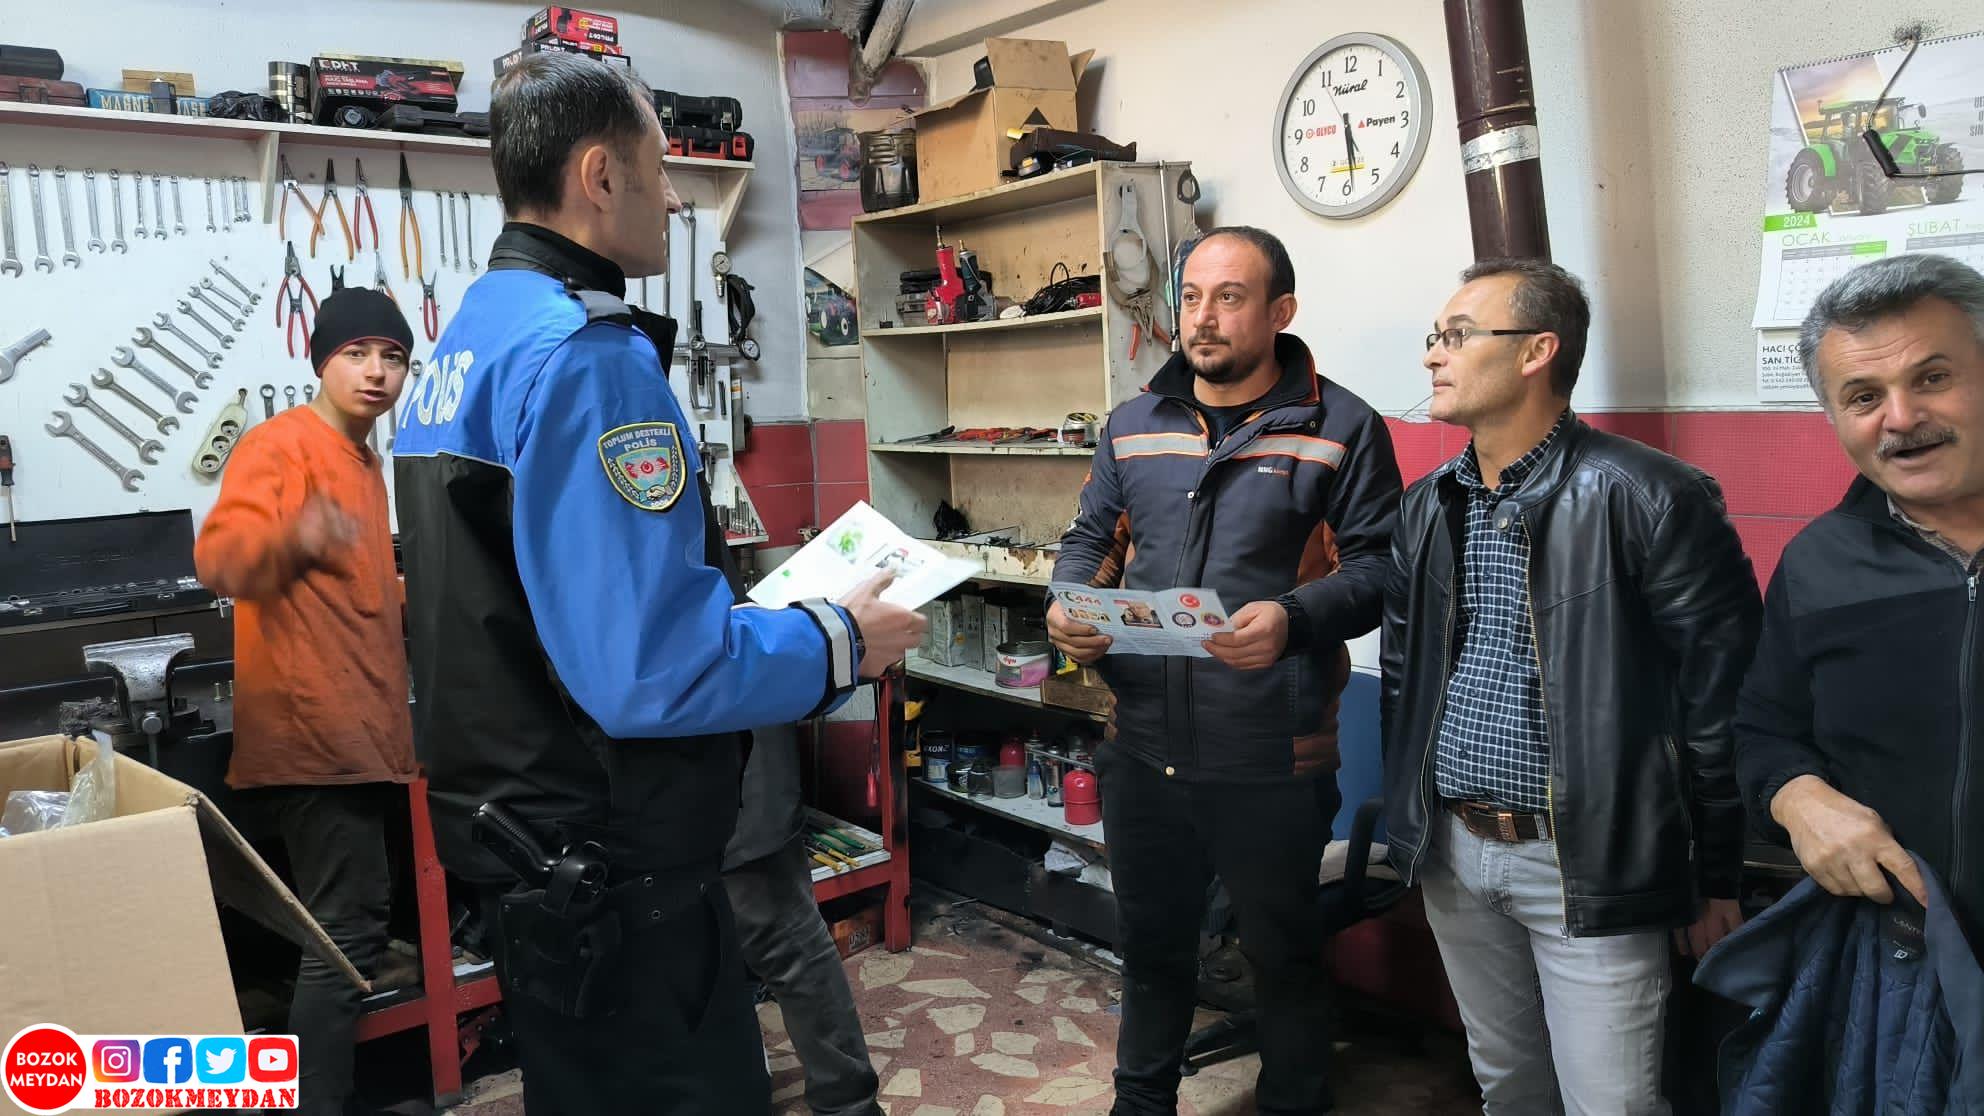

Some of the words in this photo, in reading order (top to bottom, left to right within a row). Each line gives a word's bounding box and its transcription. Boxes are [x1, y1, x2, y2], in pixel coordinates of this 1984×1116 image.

[1344, 55, 1358, 74] 12
[1378, 59, 1383, 77] 1
[1321, 70, 1332, 88] 11
[1332, 79, 1369, 96] Nüral
[1396, 81, 1405, 99] 2
[1303, 98, 1315, 117] 10
[1366, 115, 1396, 128] Payen
[1400, 110, 1409, 129] 3
[1294, 129, 1303, 145] 9
[1390, 141, 1400, 158] 4
[1300, 156, 1309, 173] 8
[1318, 176, 1326, 193] 7
[1371, 168, 1380, 185] 5
[1342, 179, 1352, 197] 6
[1783, 215, 1811, 227] 2024
[1907, 218, 1960, 237] ŞUBAT
[1781, 231, 1832, 247] OCAK
[1762, 345, 1785, 353] HACI
[602, 431, 634, 449] TOPLUM
[623, 437, 657, 452] POLİS
